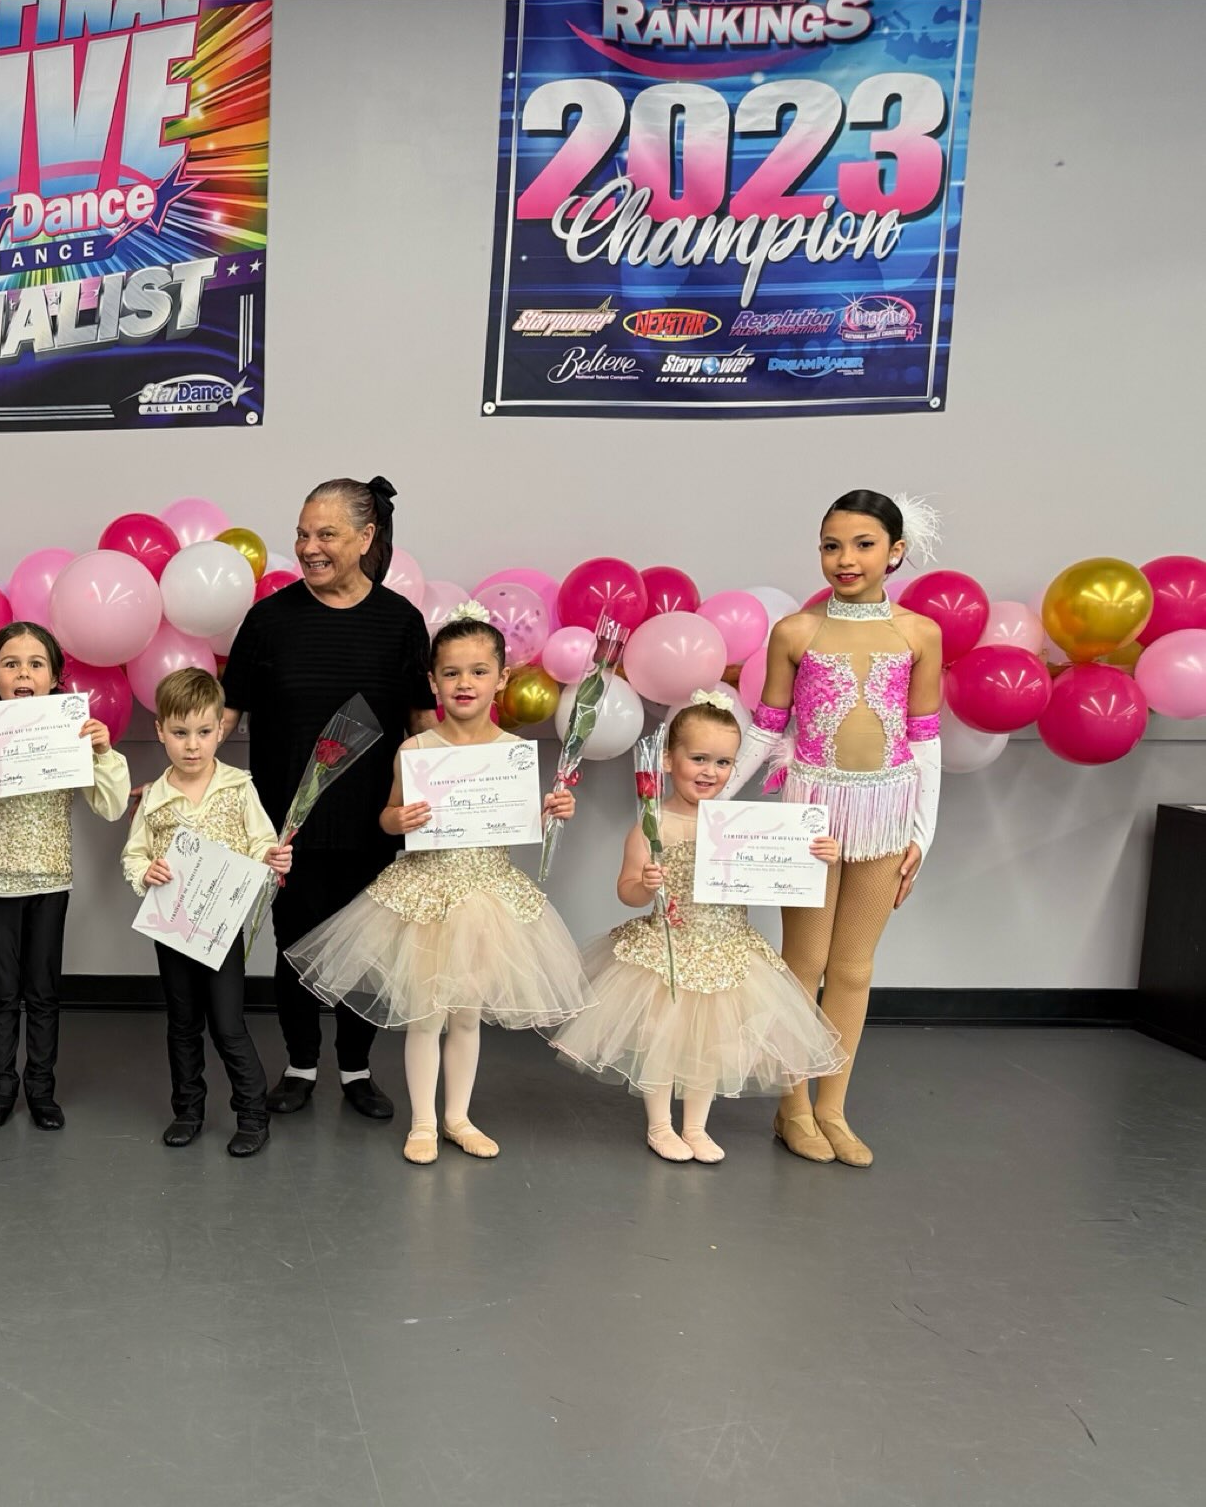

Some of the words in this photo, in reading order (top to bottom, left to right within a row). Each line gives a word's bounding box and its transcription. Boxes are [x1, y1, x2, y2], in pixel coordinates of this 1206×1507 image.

[516, 72, 944, 222] 2023
[551, 176, 905, 308] Champion
[512, 309, 618, 336] Starpower
[732, 308, 836, 331] Revolution
[547, 344, 645, 384] Believe
[137, 381, 233, 404] StarDance
[655, 376, 747, 384] INTERNATIONAL
[146, 404, 211, 413] ALLIANCE
